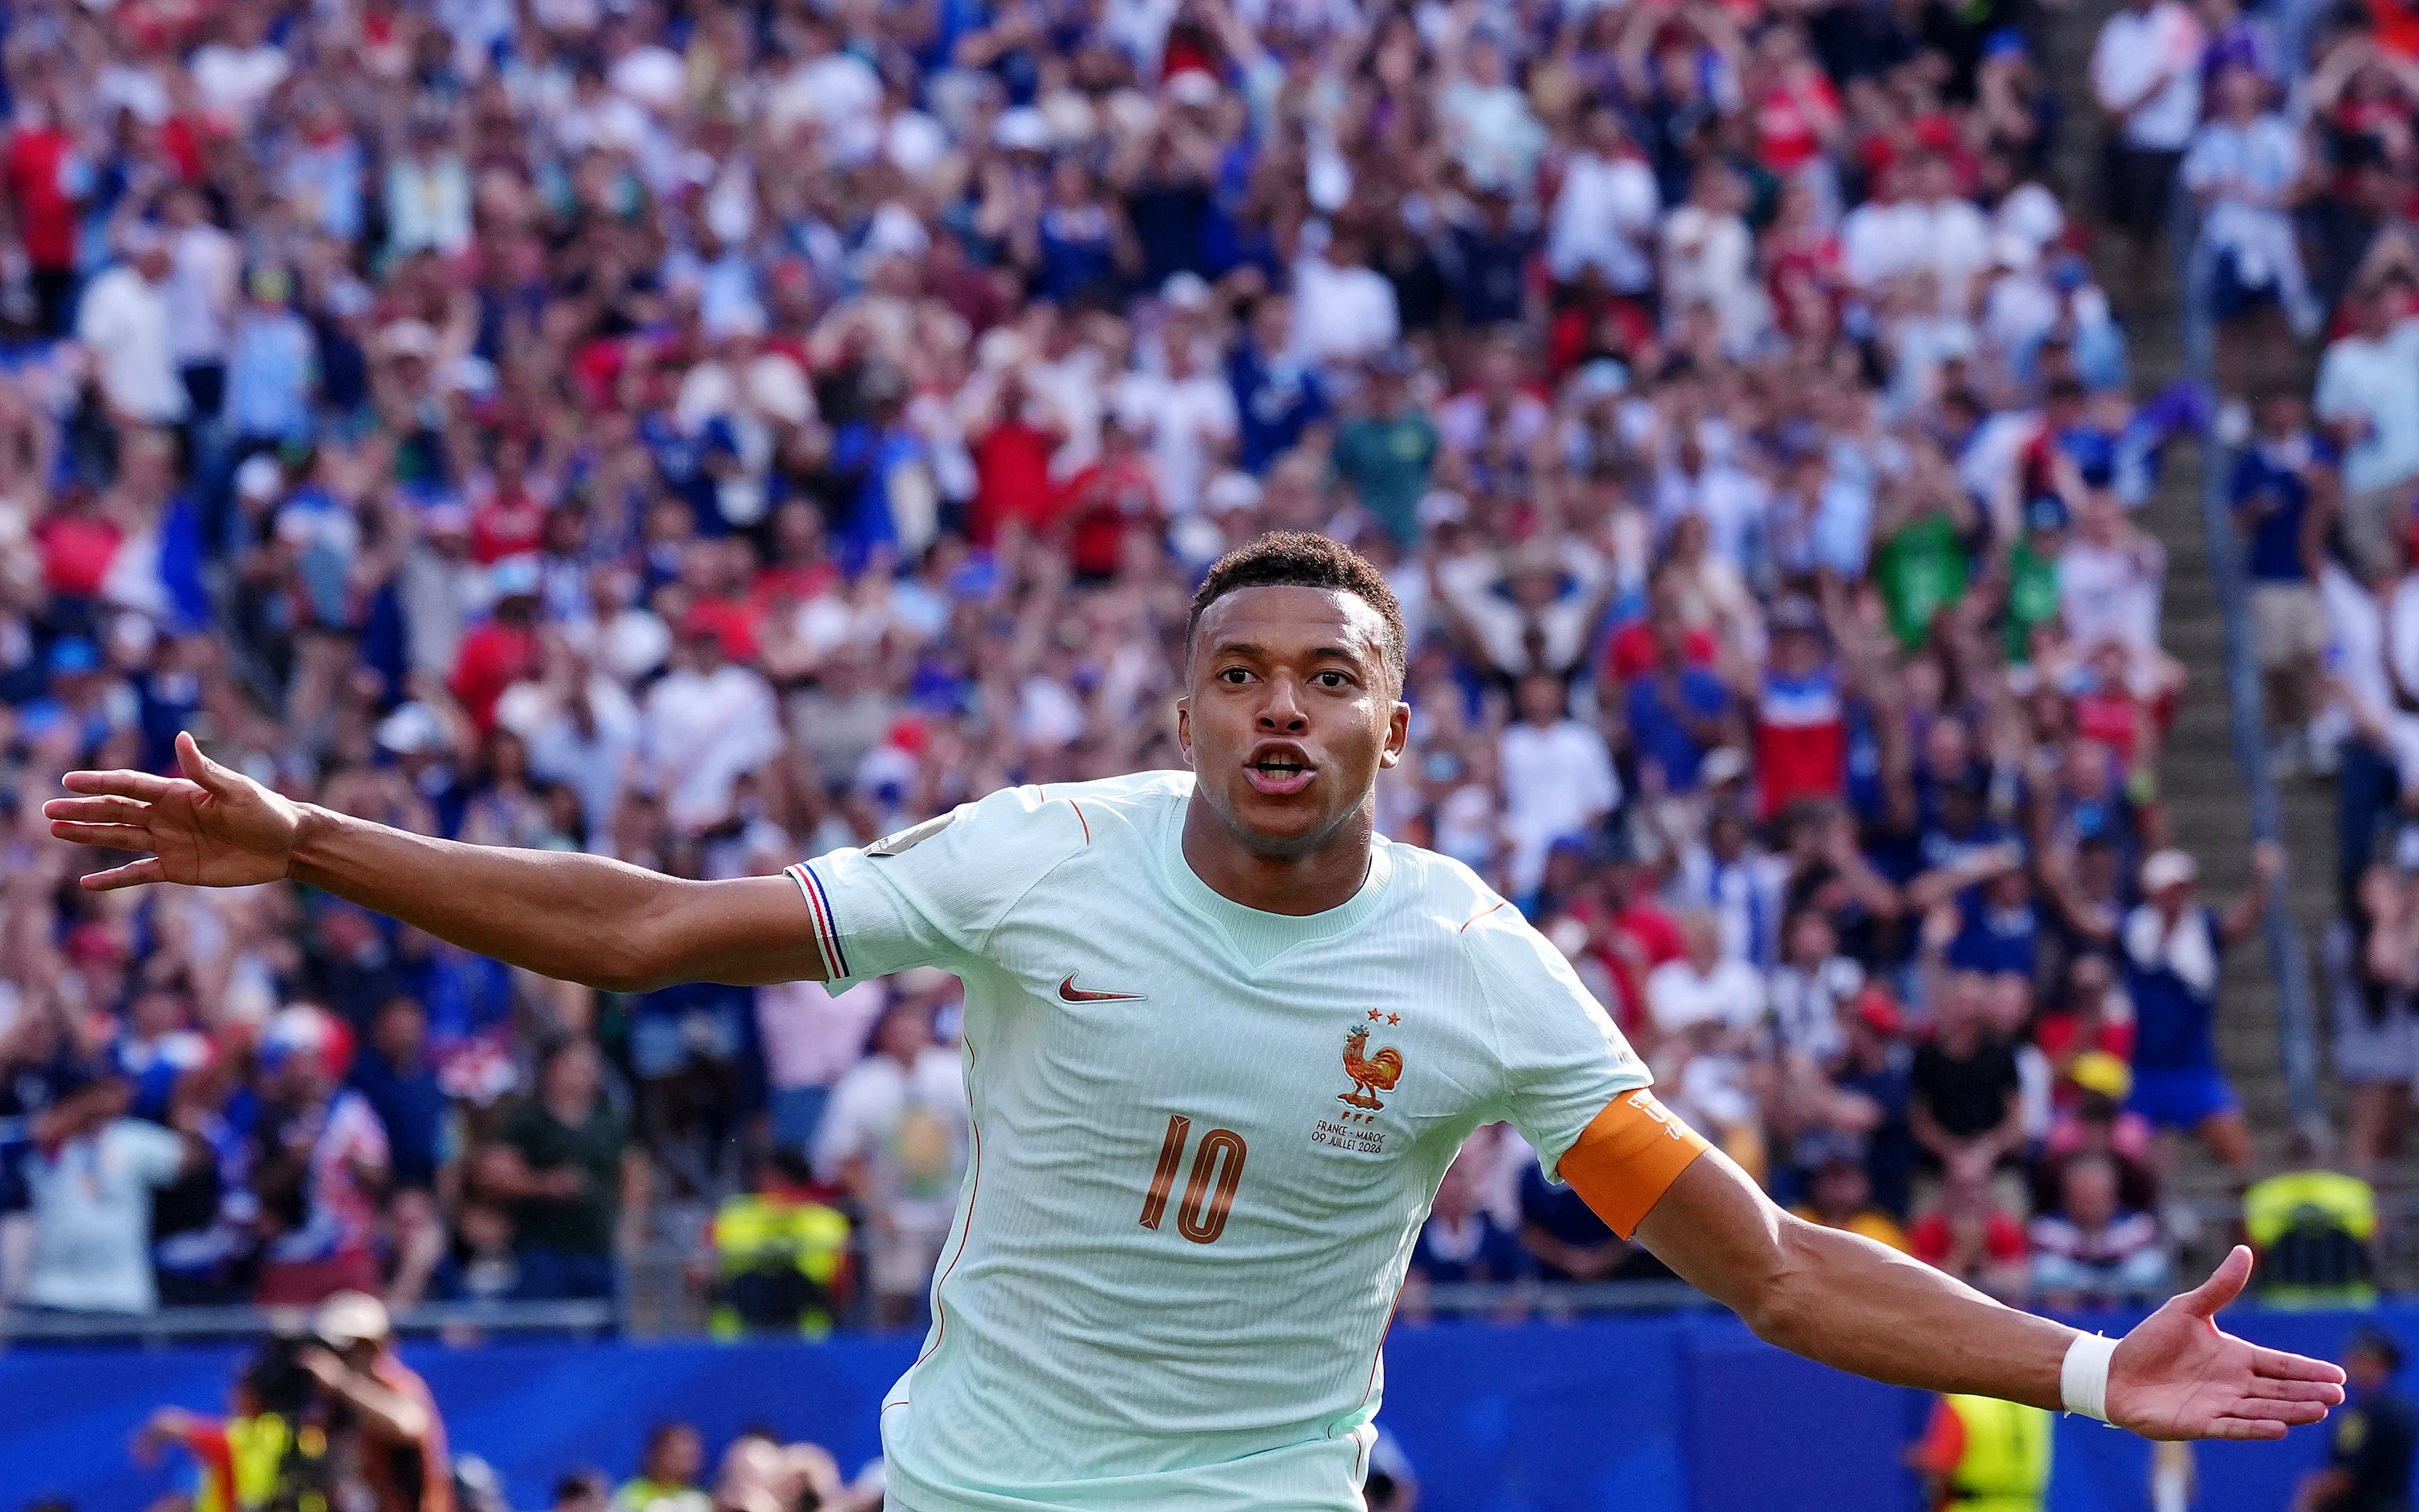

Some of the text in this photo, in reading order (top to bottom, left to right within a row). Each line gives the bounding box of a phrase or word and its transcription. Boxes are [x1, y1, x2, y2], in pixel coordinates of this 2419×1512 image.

[1341, 1111, 1375, 1124] FFF
[1311, 1131, 1382, 1153] 09 JUILLET 2026
[1317, 1120, 1347, 1136] FRANCE
[1355, 1130, 1386, 1143] MAROC
[1139, 1114, 1247, 1245] 10
